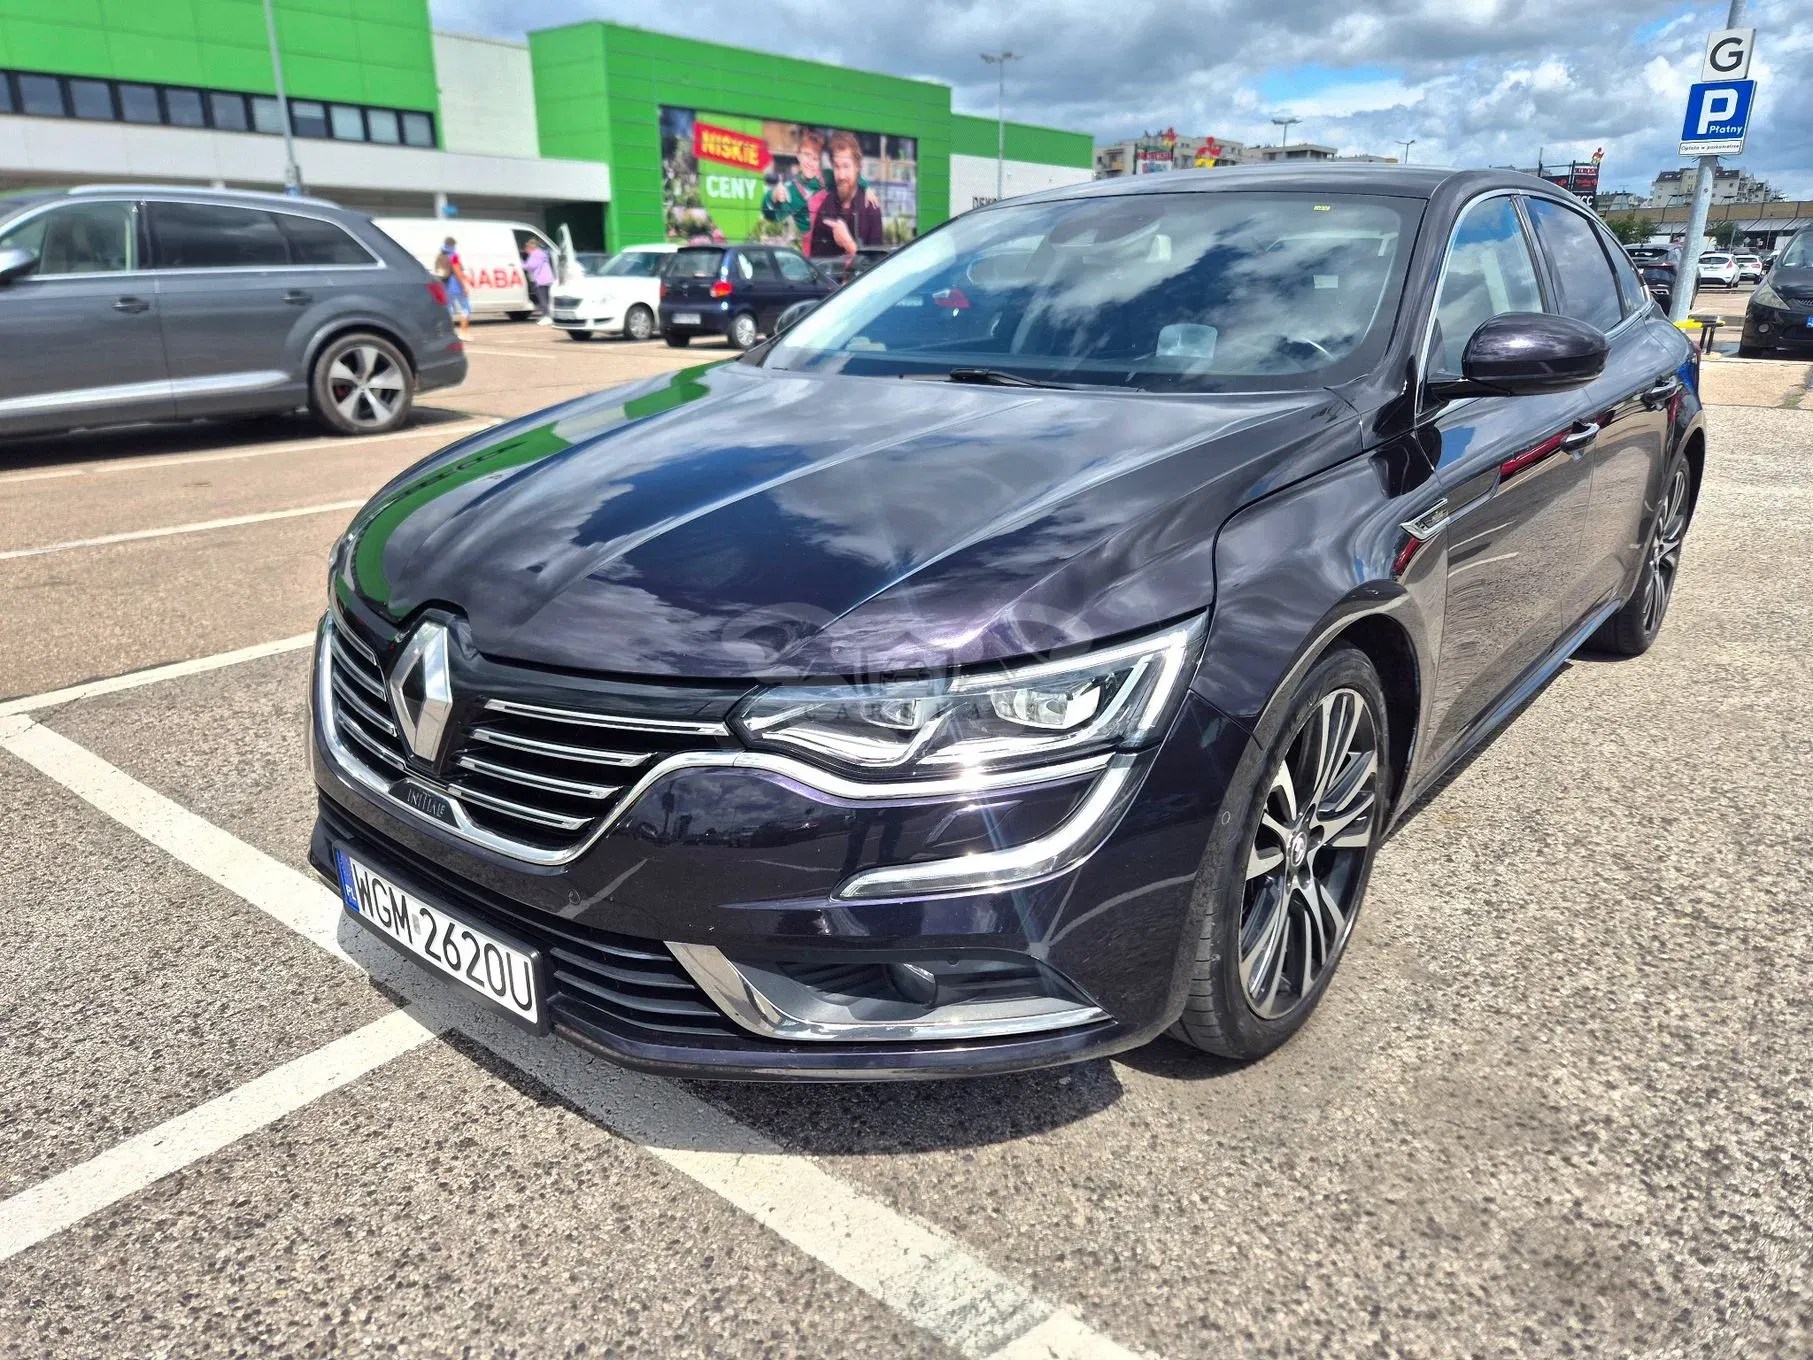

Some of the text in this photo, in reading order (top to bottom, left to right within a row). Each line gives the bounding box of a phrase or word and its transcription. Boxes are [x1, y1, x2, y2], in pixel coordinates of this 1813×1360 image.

[1709, 37, 1744, 72] G
[1697, 88, 1739, 135] P
[700, 130, 760, 166] NISKIE
[1708, 125, 1743, 137] Płatny
[706, 175, 757, 201] CENY
[345, 884, 357, 901] PL
[352, 863, 533, 1012] WGM 2620U
